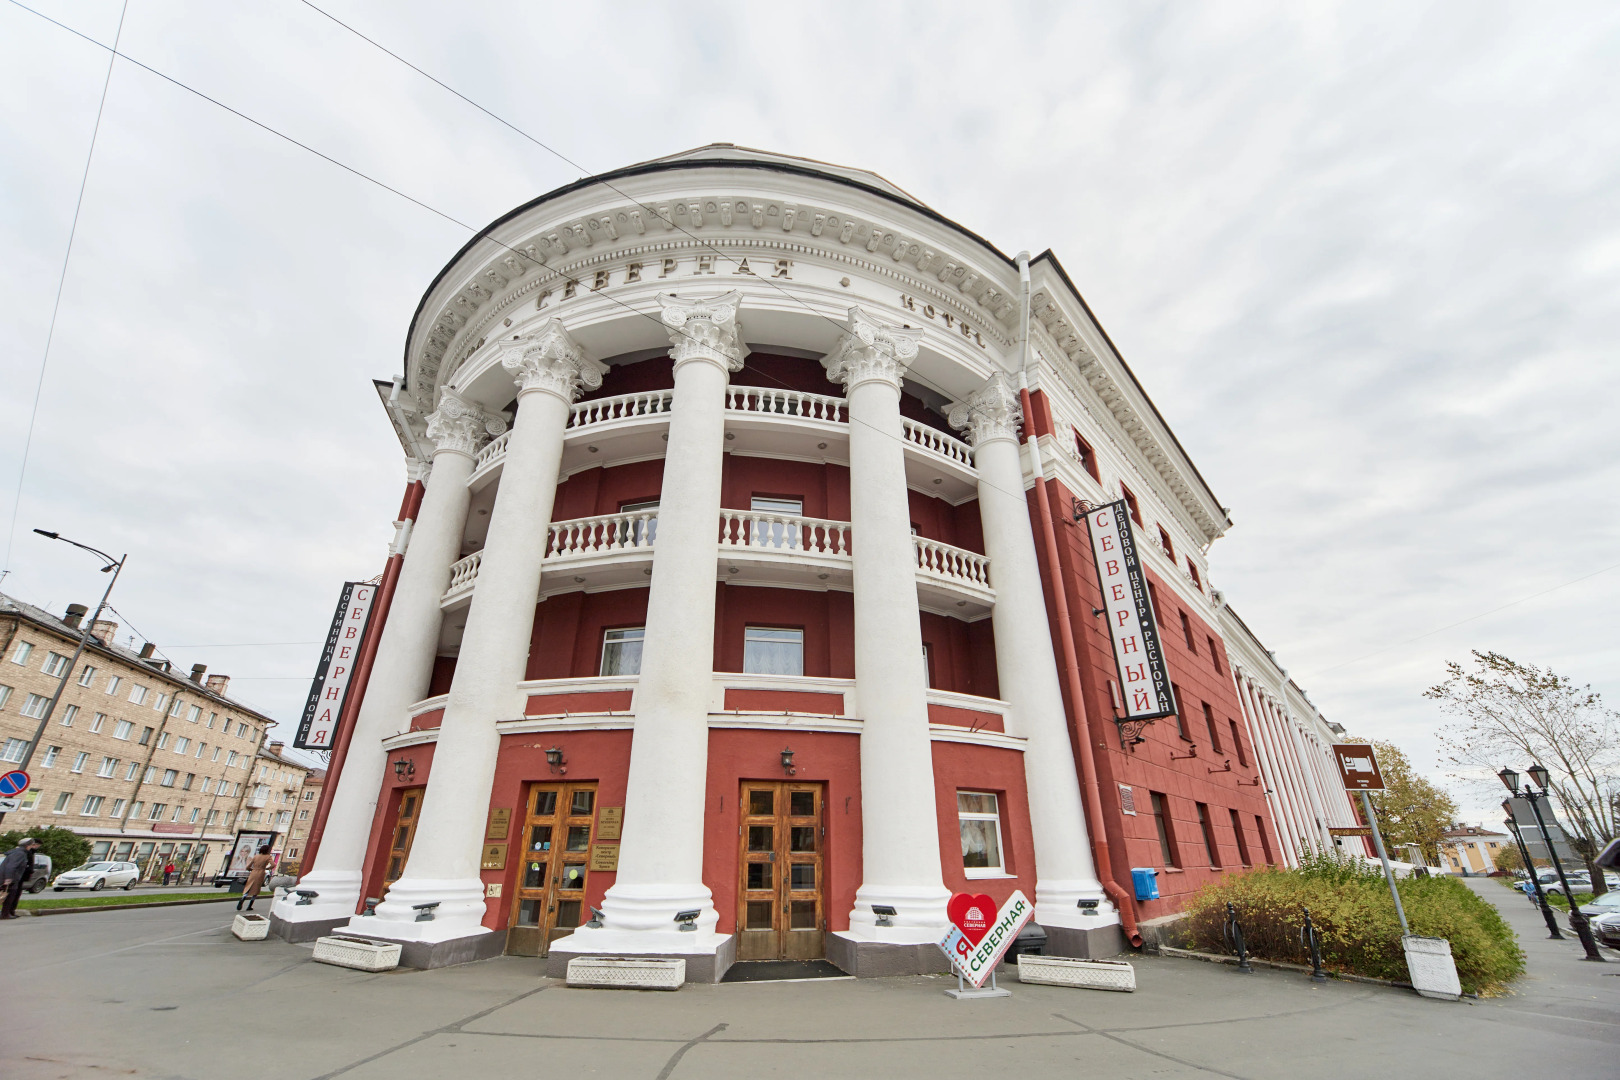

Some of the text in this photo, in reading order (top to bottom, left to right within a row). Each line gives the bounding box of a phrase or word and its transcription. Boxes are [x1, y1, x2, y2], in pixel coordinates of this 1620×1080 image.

[535, 255, 794, 311] СЕВЕРНАЯ
[900, 293, 986, 349] HOTEL
[323, 586, 352, 662] ГОСТИНИЦА
[1096, 511, 1152, 712] СЕВЕРНЫЙ
[1114, 503, 1170, 712] ДЕЛОВОЙ ЦЕНТР РЕСТОРАН
[312, 588, 369, 744] СЕВЕРНАЯ
[299, 694, 319, 742] HOTEL
[956, 935, 975, 961] Я
[970, 900, 1026, 972] СЕВЕРНАЯ
